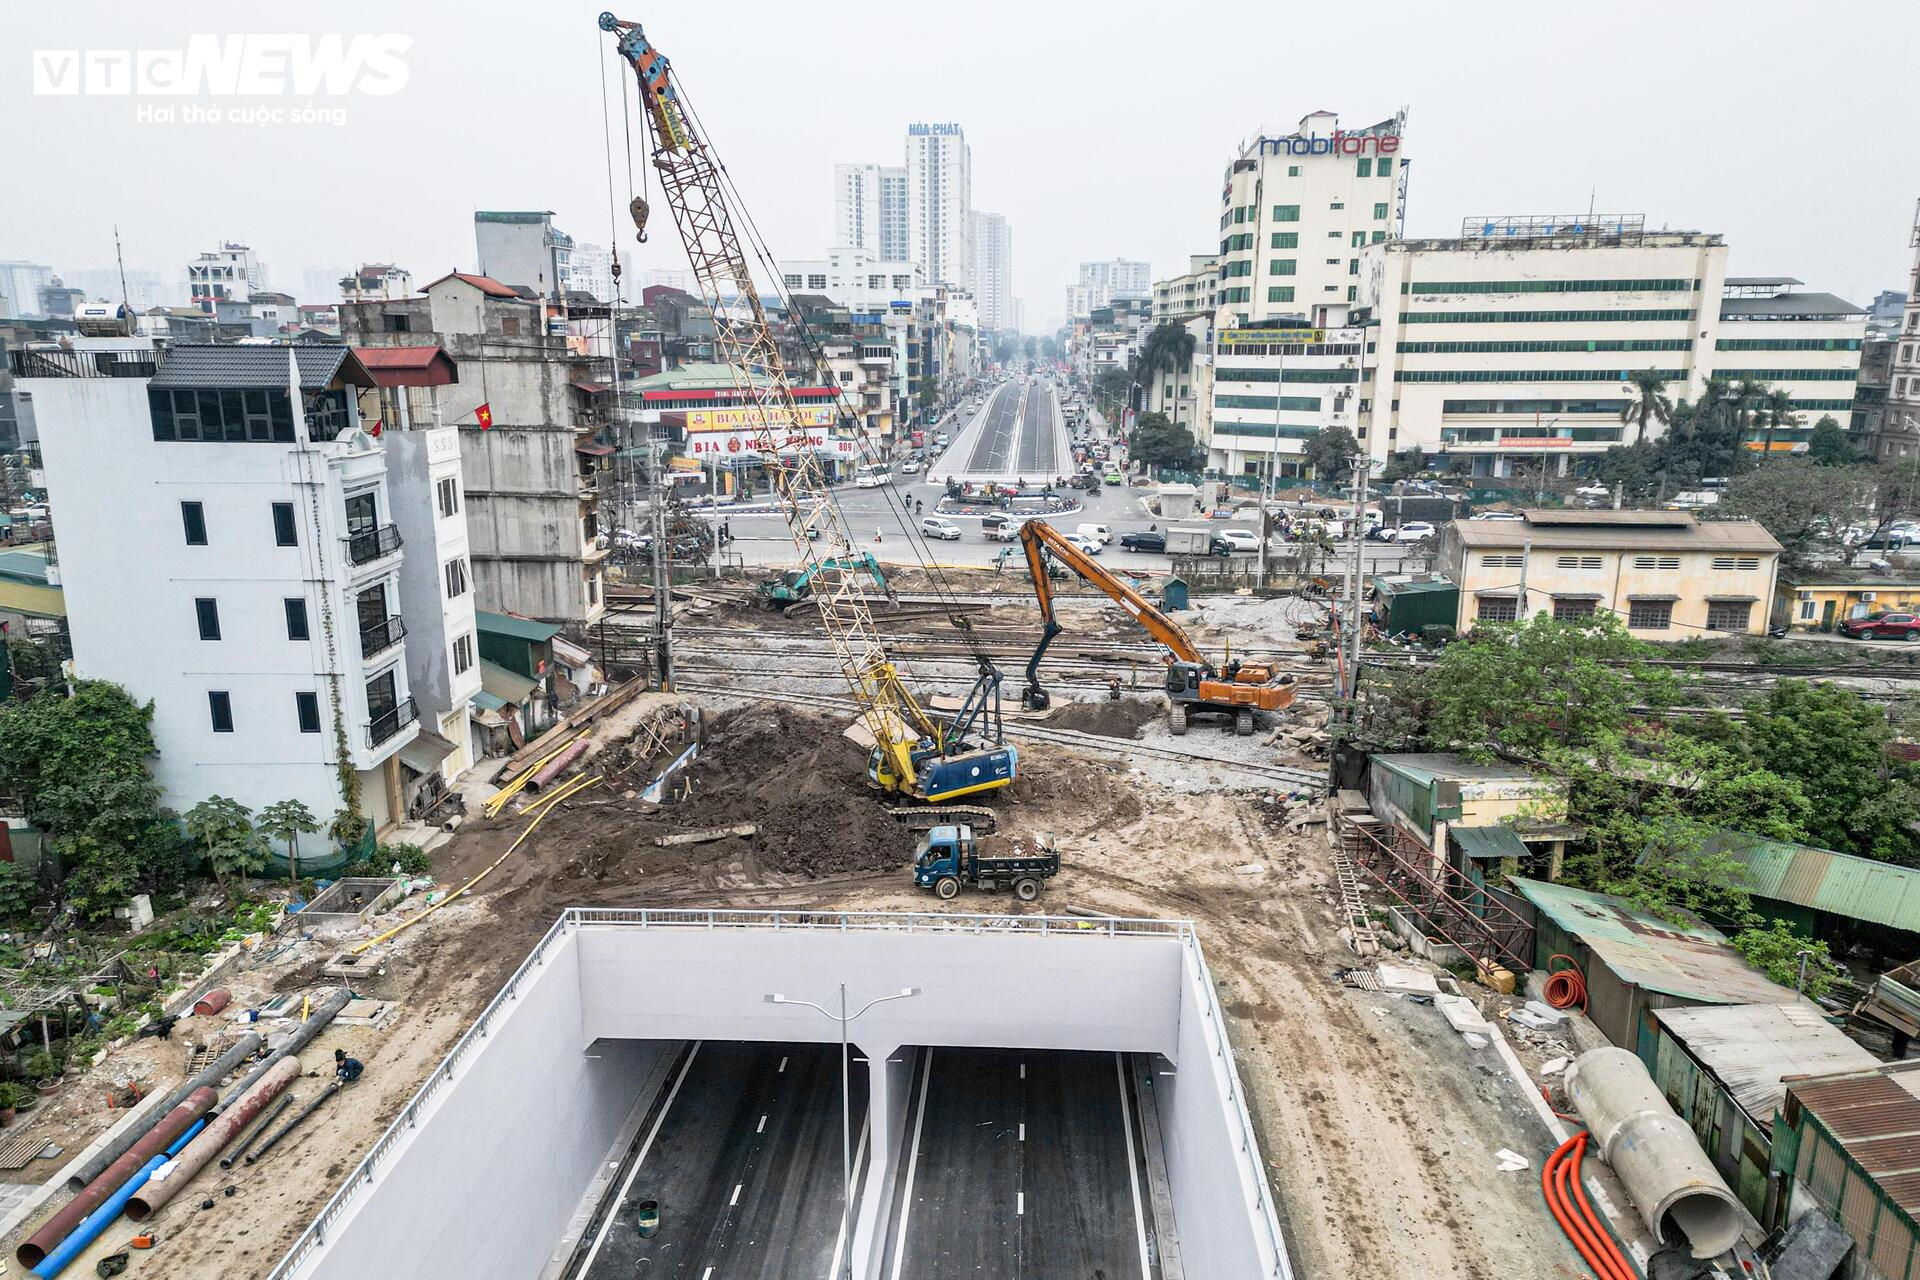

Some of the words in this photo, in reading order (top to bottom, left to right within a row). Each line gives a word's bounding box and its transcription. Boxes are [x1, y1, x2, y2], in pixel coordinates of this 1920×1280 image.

[661, 101, 685, 145] KOBELCO
[1259, 130, 1400, 156] mobifone
[717, 412, 737, 424] BIA
[694, 440, 720, 453] BIA
[838, 442, 852, 452] 809
[1047, 536, 1071, 557] HITACHI
